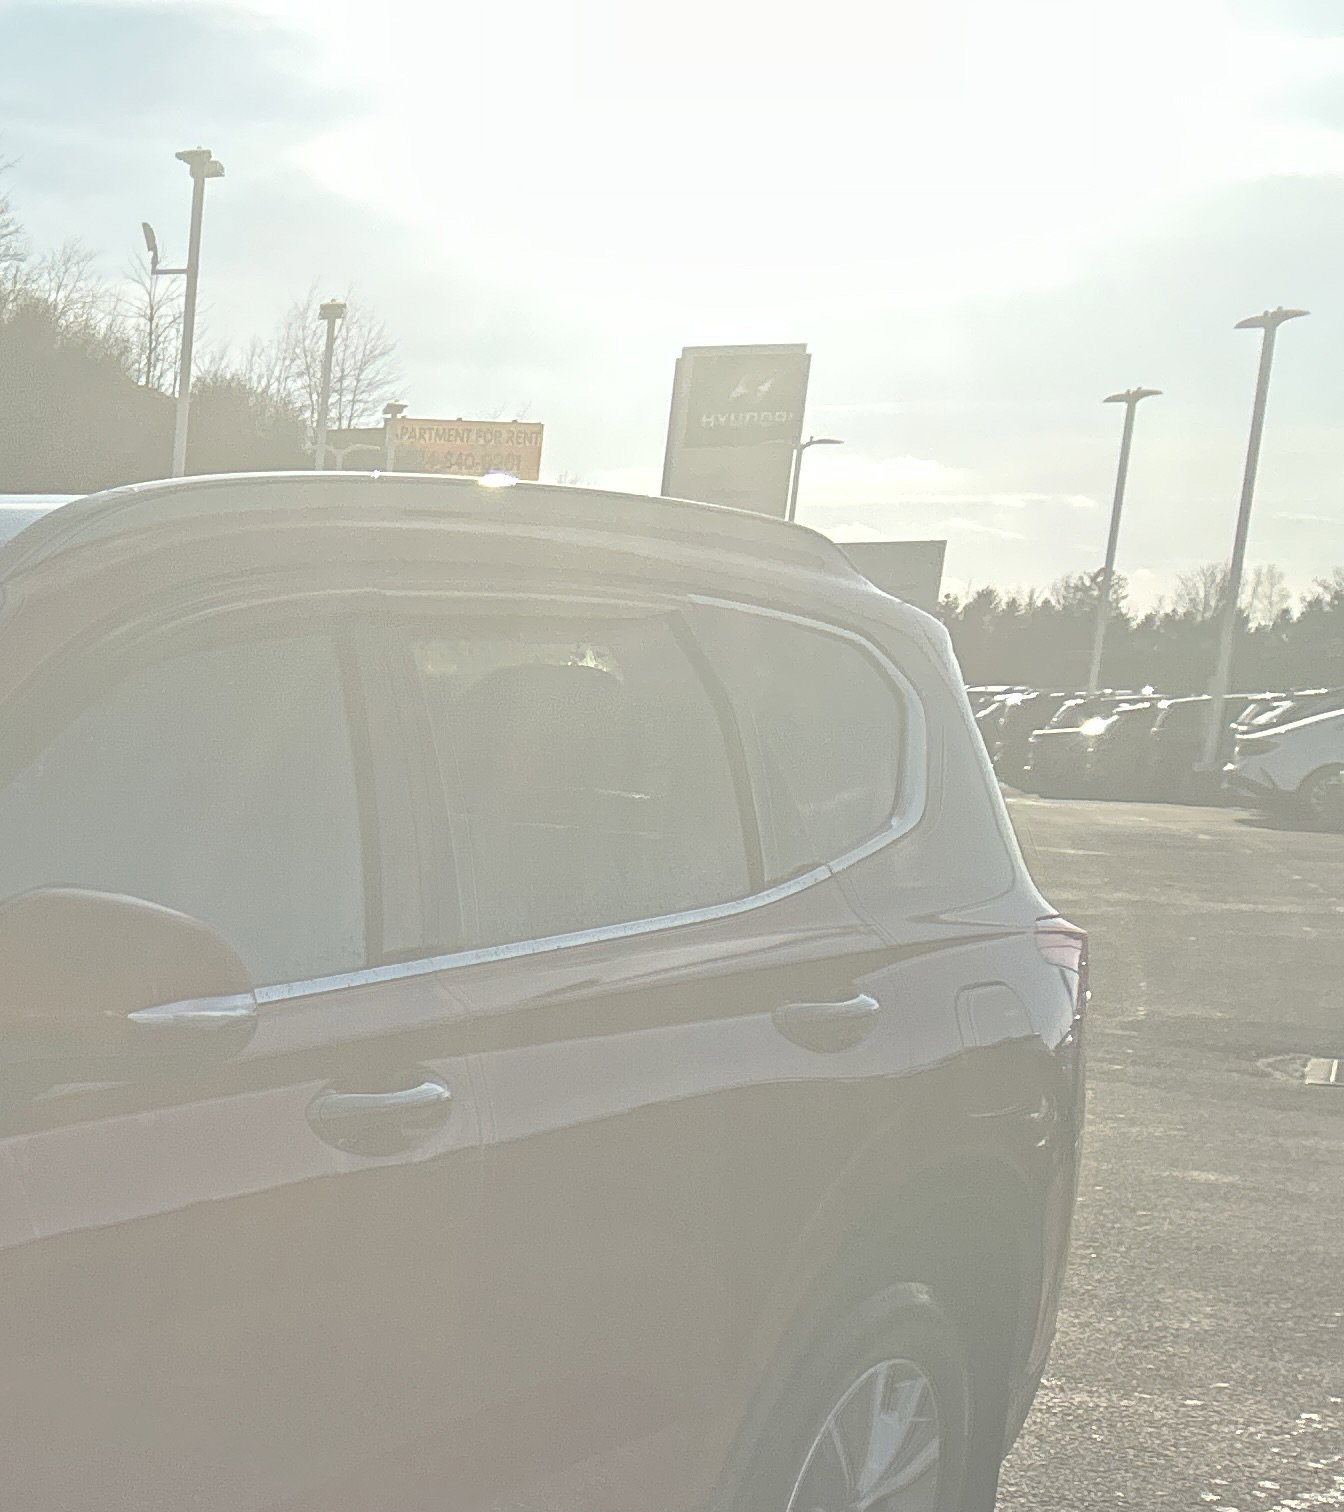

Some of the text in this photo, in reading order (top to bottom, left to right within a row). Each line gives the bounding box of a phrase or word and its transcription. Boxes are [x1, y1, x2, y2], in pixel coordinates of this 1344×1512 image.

[700, 410, 795, 429] HYUNDAI
[475, 429, 503, 445] FOR
[505, 429, 540, 446] RENT
